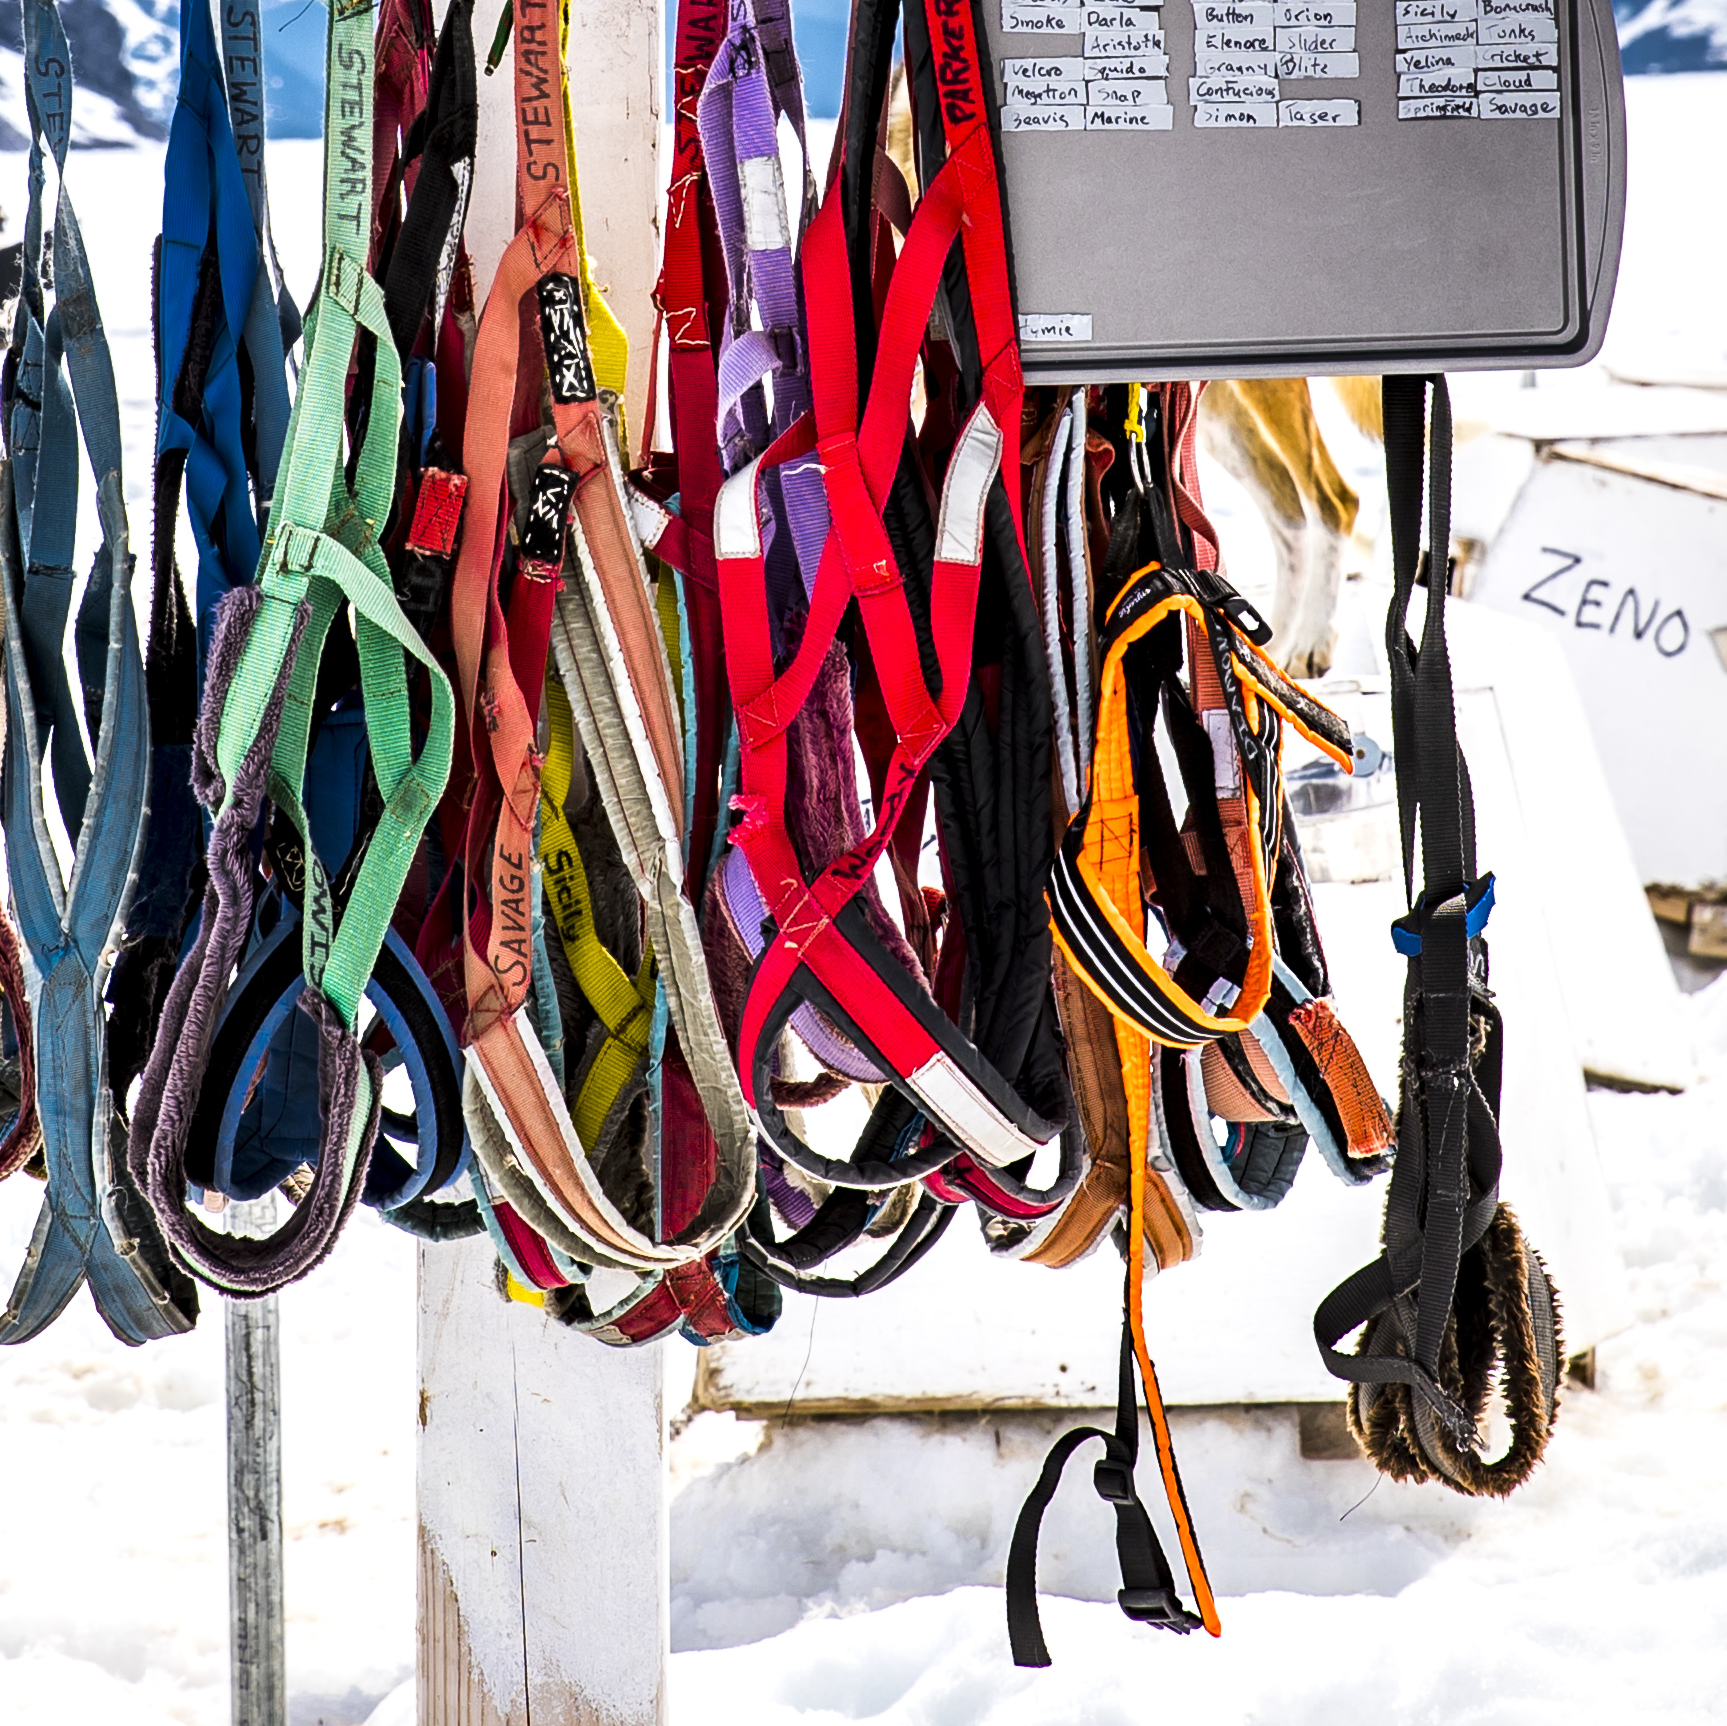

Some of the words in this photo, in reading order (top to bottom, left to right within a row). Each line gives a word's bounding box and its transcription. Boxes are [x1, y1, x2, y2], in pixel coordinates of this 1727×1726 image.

[1009, 10, 1066, 30] Smoke
[1087, 11, 1137, 28] Darla
[1205, 6, 1254, 25] Button
[1284, 7, 1333, 25] Orion
[1402, 3, 1458, 20] Sicily
[1090, 33, 1162, 53] Aristotle
[1205, 32, 1270, 51] Elenore
[1287, 32, 1337, 52] Slider
[1402, 54, 1456, 72] Yelina
[1482, 48, 1549, 66] Cricket
[1012, 61, 1063, 78] Velcro
[1088, 60, 1147, 81] Squido
[1204, 58, 1268, 76] Granny
[1482, 72, 1533, 89] Cloud
[225, 4, 263, 188] STEWART
[1012, 82, 1079, 105] Megatron
[1097, 87, 1142, 104] Snap
[1205, 107, 1257, 125] Simon
[1285, 101, 1343, 125] Taser
[1488, 96, 1558, 118] Savage
[1090, 110, 1151, 126] Marine
[337, 42, 367, 236] STEWART
[1520, 546, 1691, 658] ZENO
[543, 848, 584, 943] Sicily
[493, 843, 529, 987] SAVAGE
